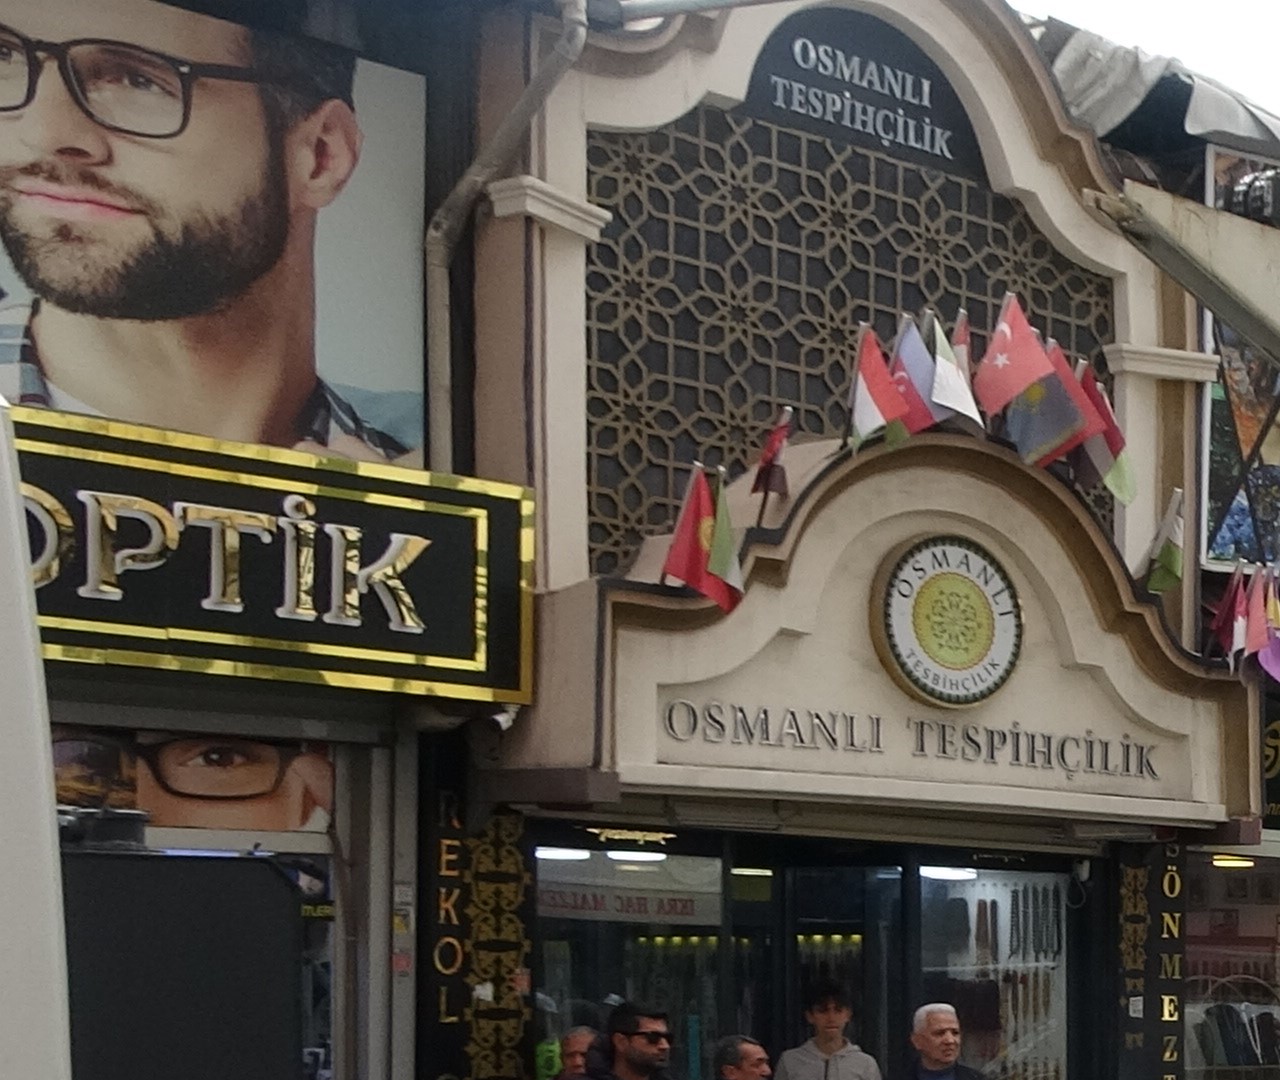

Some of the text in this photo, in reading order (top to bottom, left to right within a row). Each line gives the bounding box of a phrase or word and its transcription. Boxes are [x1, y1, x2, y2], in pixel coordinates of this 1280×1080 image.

[793, 37, 932, 108] OSMANLI
[770, 74, 954, 160] TESPİHÇİLİK
[897, 548, 1014, 616] OSMANLI
[664, 699, 1161, 781] OSMANLI TESPİHÇİLİK
